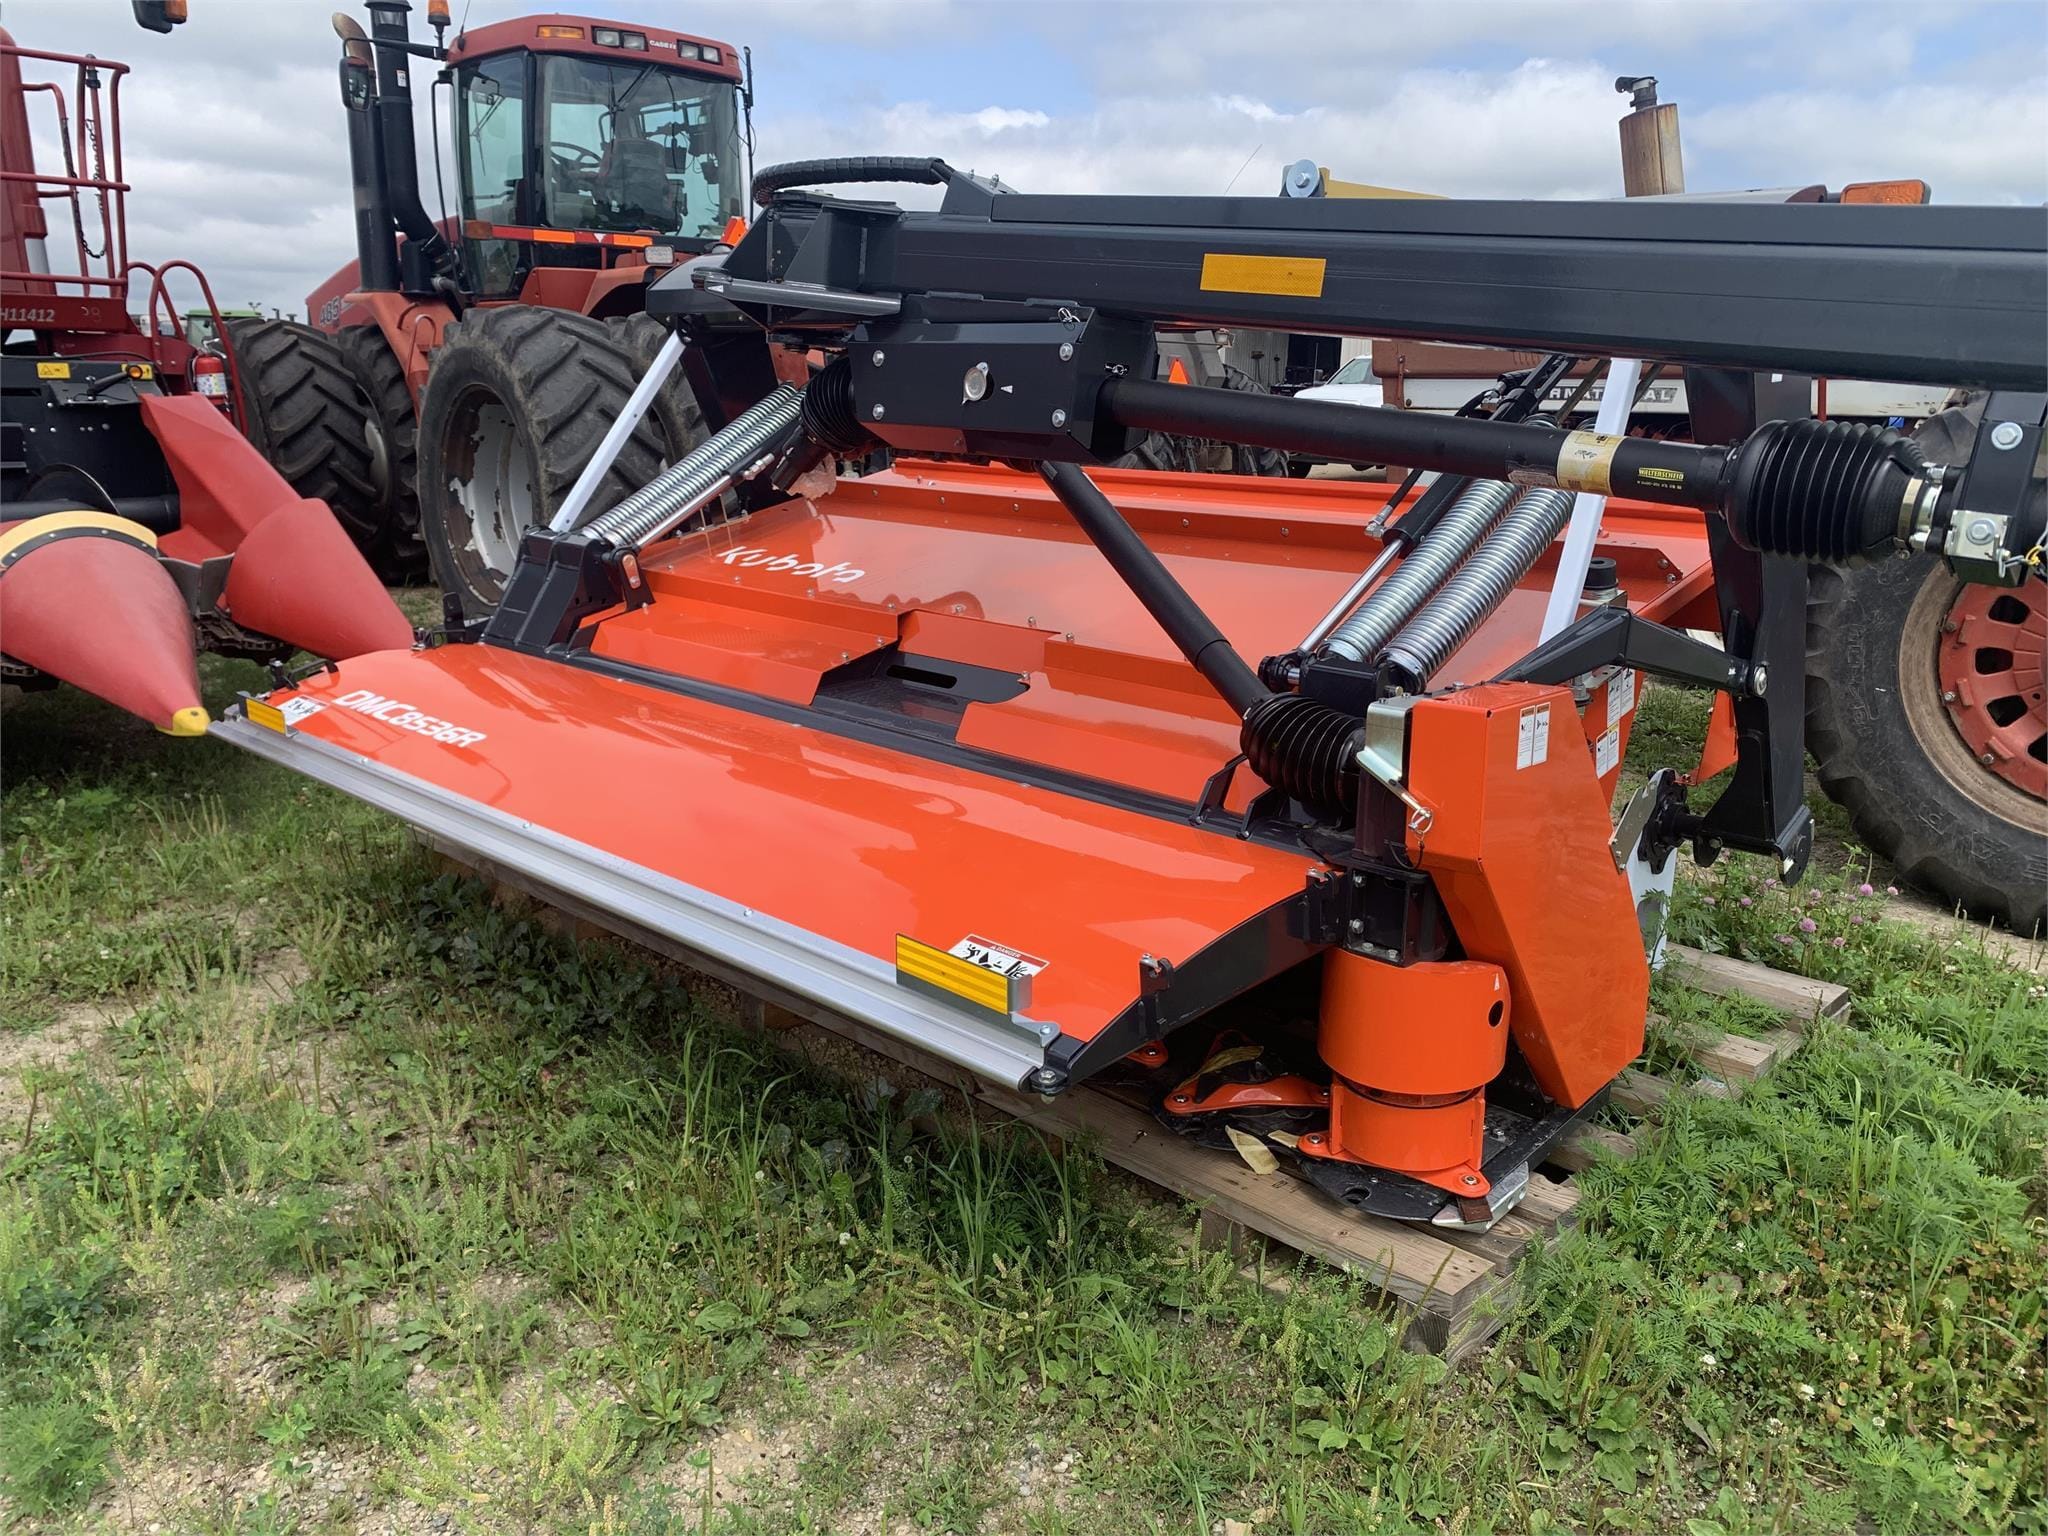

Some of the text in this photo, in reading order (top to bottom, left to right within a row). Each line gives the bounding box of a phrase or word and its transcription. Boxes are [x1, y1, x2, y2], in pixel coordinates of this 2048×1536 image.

[650, 39, 669, 49] CASE
[716, 545, 866, 583] Kubota
[331, 689, 488, 748] DMC8536R
[996, 946, 1022, 958] DANGER
